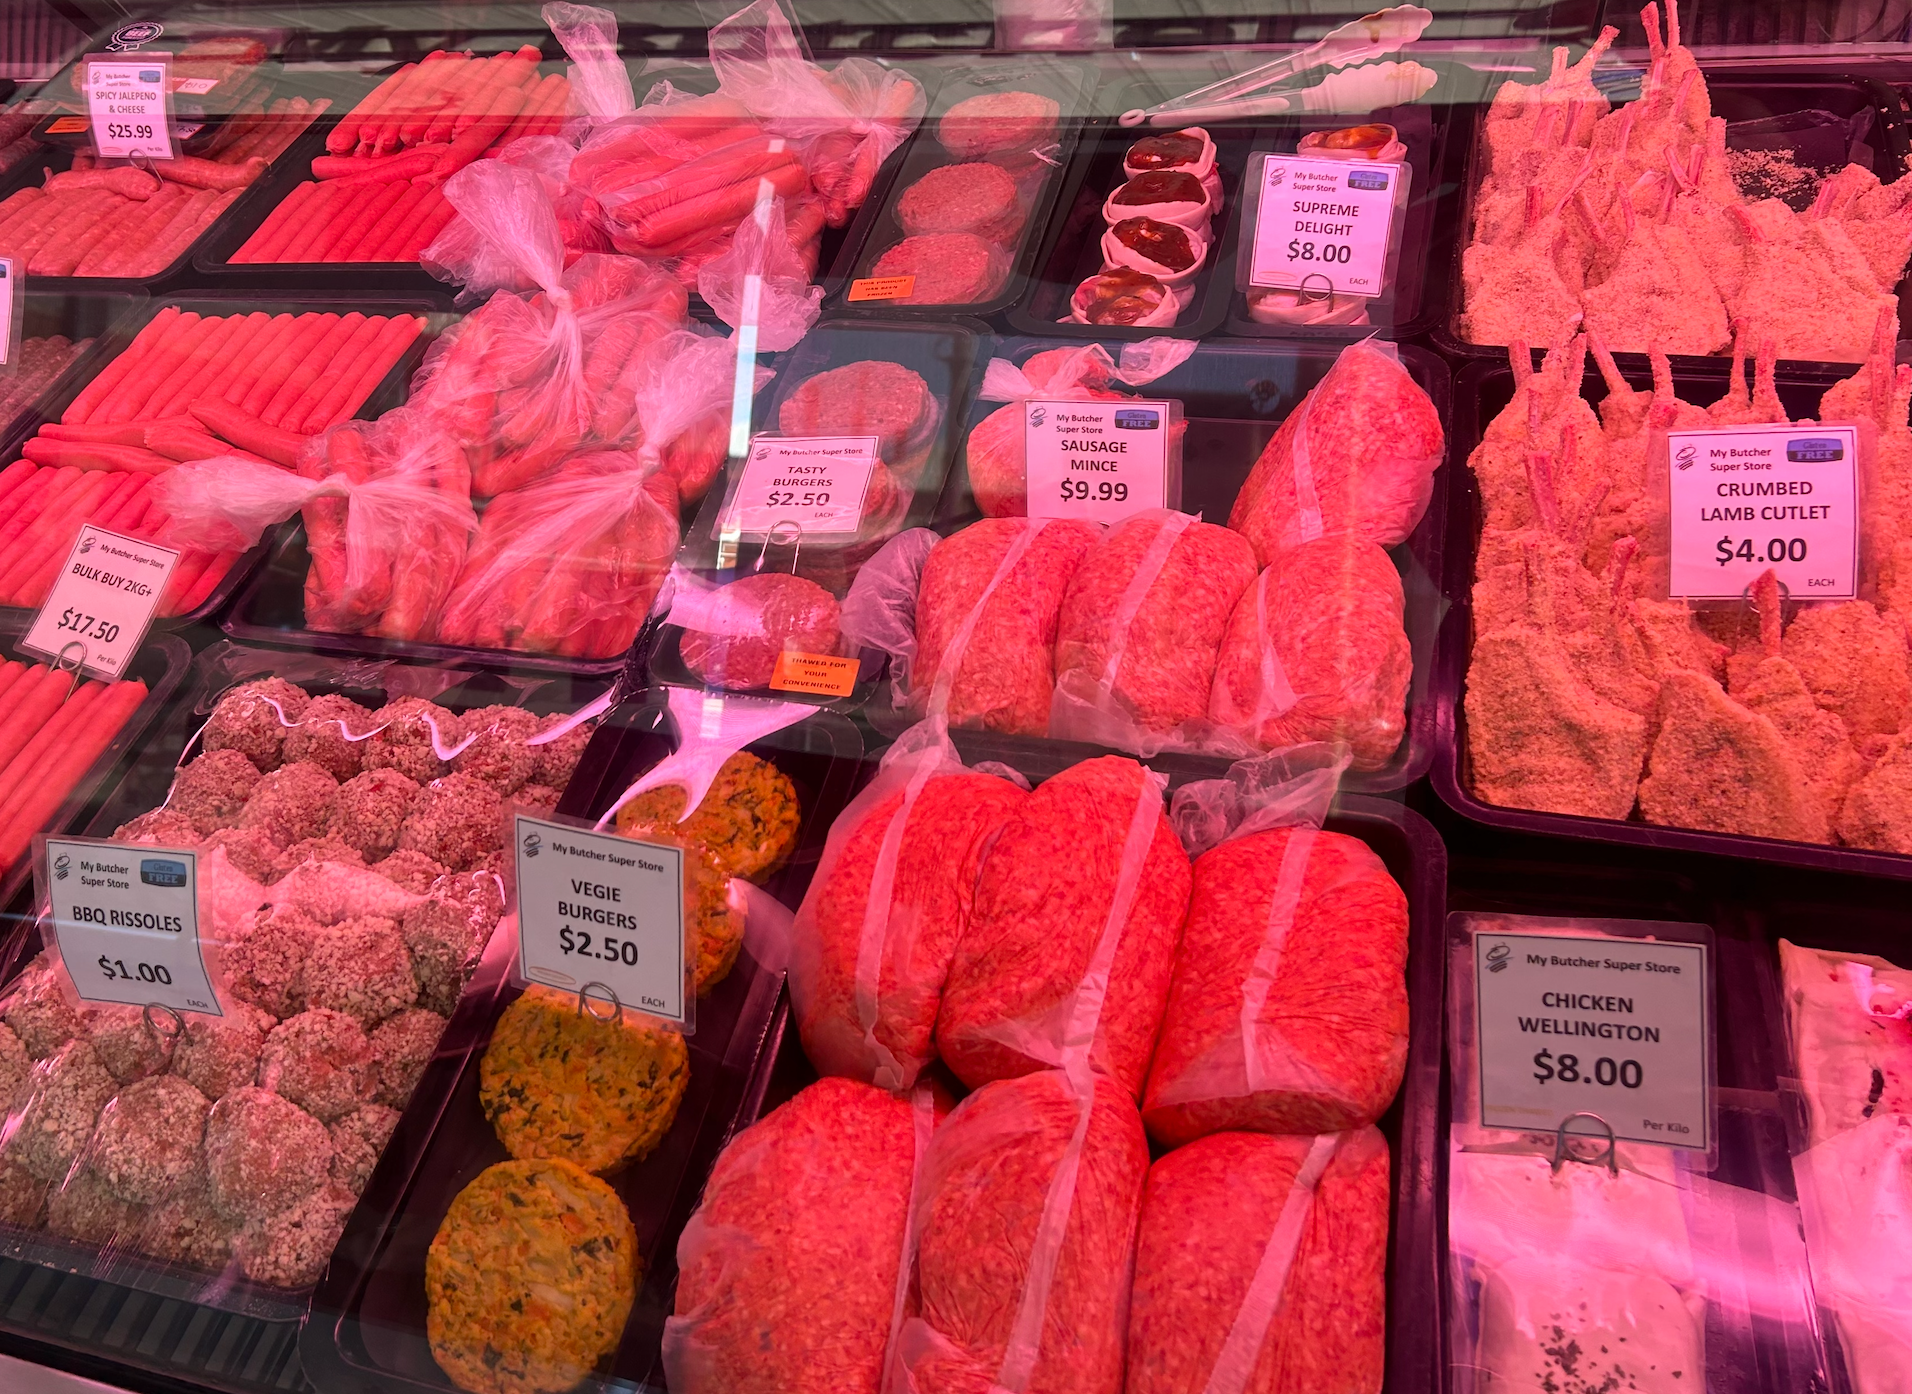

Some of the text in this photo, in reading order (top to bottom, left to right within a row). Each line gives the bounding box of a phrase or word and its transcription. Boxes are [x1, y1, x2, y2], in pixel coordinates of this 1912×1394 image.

[96, 92, 156, 100] SPICY JALEPENO
[109, 105, 145, 114] & CHEESE
[108, 123, 153, 139] $25.99
[1294, 172, 1338, 182] My Butcher
[1293, 183, 1337, 192] Super Store
[1354, 181, 1381, 189] FREE
[1293, 201, 1360, 217] SUPREME
[1295, 221, 1353, 236] DELIGHT
[1287, 238, 1351, 264] $8.00
[1057, 415, 1103, 423] My Butcher
[1122, 420, 1151, 428] FREE
[1056, 426, 1103, 434] Super Store
[1061, 440, 1128, 453] SAUSAGE
[1710, 448, 1771, 459] My Butcher
[1796, 450, 1834, 460] FREE
[1071, 460, 1118, 472] MINCE
[1710, 462, 1772, 473] Super Store
[1060, 478, 1128, 502] $9.99
[1717, 481, 1813, 497] CRUMBED
[766, 491, 830, 508] $2.50
[1701, 505, 1831, 521] LAMB CUTLET
[100, 544, 165, 569] My Butcher Super Store
[1716, 536, 1807, 567] $4.00
[72, 563, 152, 597] BULK BUY 2KG+
[1808, 579, 1835, 587] EACH
[57, 607, 120, 643] $17.50
[97, 654, 117, 666] Per Kilo
[792, 658, 827, 666] THAWED
[783, 680, 841, 690] CONVENIENCE
[552, 842, 665, 873] My Butcher Super Store
[80, 861, 129, 875] My Butcher
[81, 877, 130, 889] Super Store
[148, 872, 178, 884] FREE
[571, 879, 621, 903] VEGIE
[73, 906, 182, 933] BBQ RISSOLES
[558, 901, 638, 930] BURGERS
[559, 925, 639, 966] $2.50
[98, 955, 172, 986] $1.00
[1527, 954, 1681, 974] My Butcher Super Store
[187, 999, 209, 1009] EACH
[642, 996, 666, 1009] EACH
[1541, 992, 1634, 1013] CHICKEN
[1518, 1017, 1661, 1043] WELLINGTON
[1533, 1048, 1644, 1089] $8.00
[1643, 1119, 1690, 1135] Per Kilo
